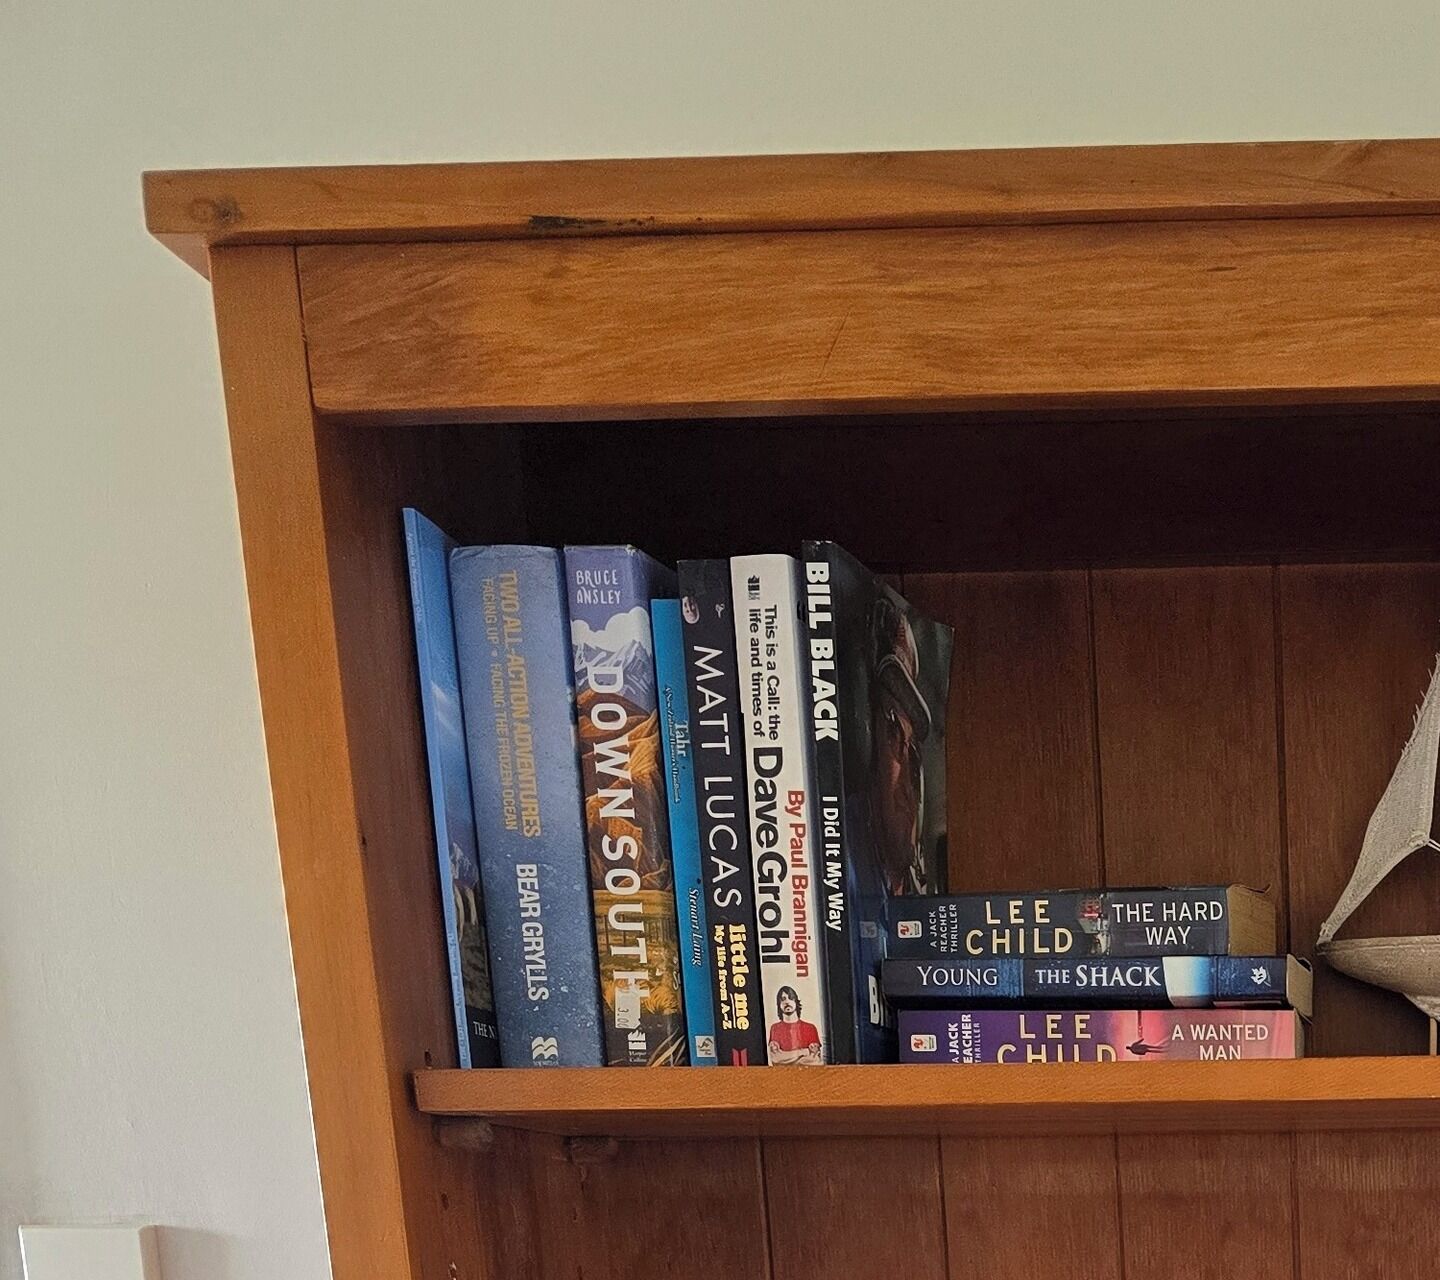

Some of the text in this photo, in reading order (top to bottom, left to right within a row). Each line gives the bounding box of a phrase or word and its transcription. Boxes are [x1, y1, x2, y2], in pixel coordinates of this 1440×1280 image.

[576, 569, 618, 587] BRUCE
[577, 586, 621, 604] ANSLEY
[805, 562, 839, 742] BILL BLACK
[749, 609, 765, 737] life and times of
[765, 605, 780, 740] This is a Call: the
[482, 576, 518, 830] FACING UP THE FROZEN OCEAN
[500, 570, 541, 838] TWO ADVENTURES
[587, 666, 636, 819] DOWN
[675, 720, 691, 757] Tahr
[693, 645, 742, 908] MATT LUCAS
[823, 807, 840, 838] Did
[824, 843, 841, 857] It
[784, 790, 809, 978] By Paul Brannigan
[823, 862, 842, 890] My
[602, 835, 651, 1000] SOUTH
[825, 892, 844, 932] Way
[929, 911, 937, 937] JACK
[939, 905, 947, 952] REACHER
[949, 904, 958, 953] THRILLER
[985, 900, 1051, 925] LEE
[1112, 901, 1224, 922] THE HARD
[516, 864, 549, 1000] BEAR GRYLLS
[966, 927, 1073, 955] CHILD
[1145, 925, 1192, 946] WAY
[712, 925, 728, 1000] My from
[729, 923, 750, 1030] little me
[916, 966, 999, 986] YOUNG
[1075, 964, 1161, 987] SHACK
[948, 1022, 959, 1055] JACK
[961, 1014, 972, 1063] EACHER
[1019, 1013, 1092, 1040] LEE
[1171, 1023, 1269, 1041] A WANTED
[997, 1043, 1117, 1063] CHILD
[1199, 1044, 1241, 1060] MAN
